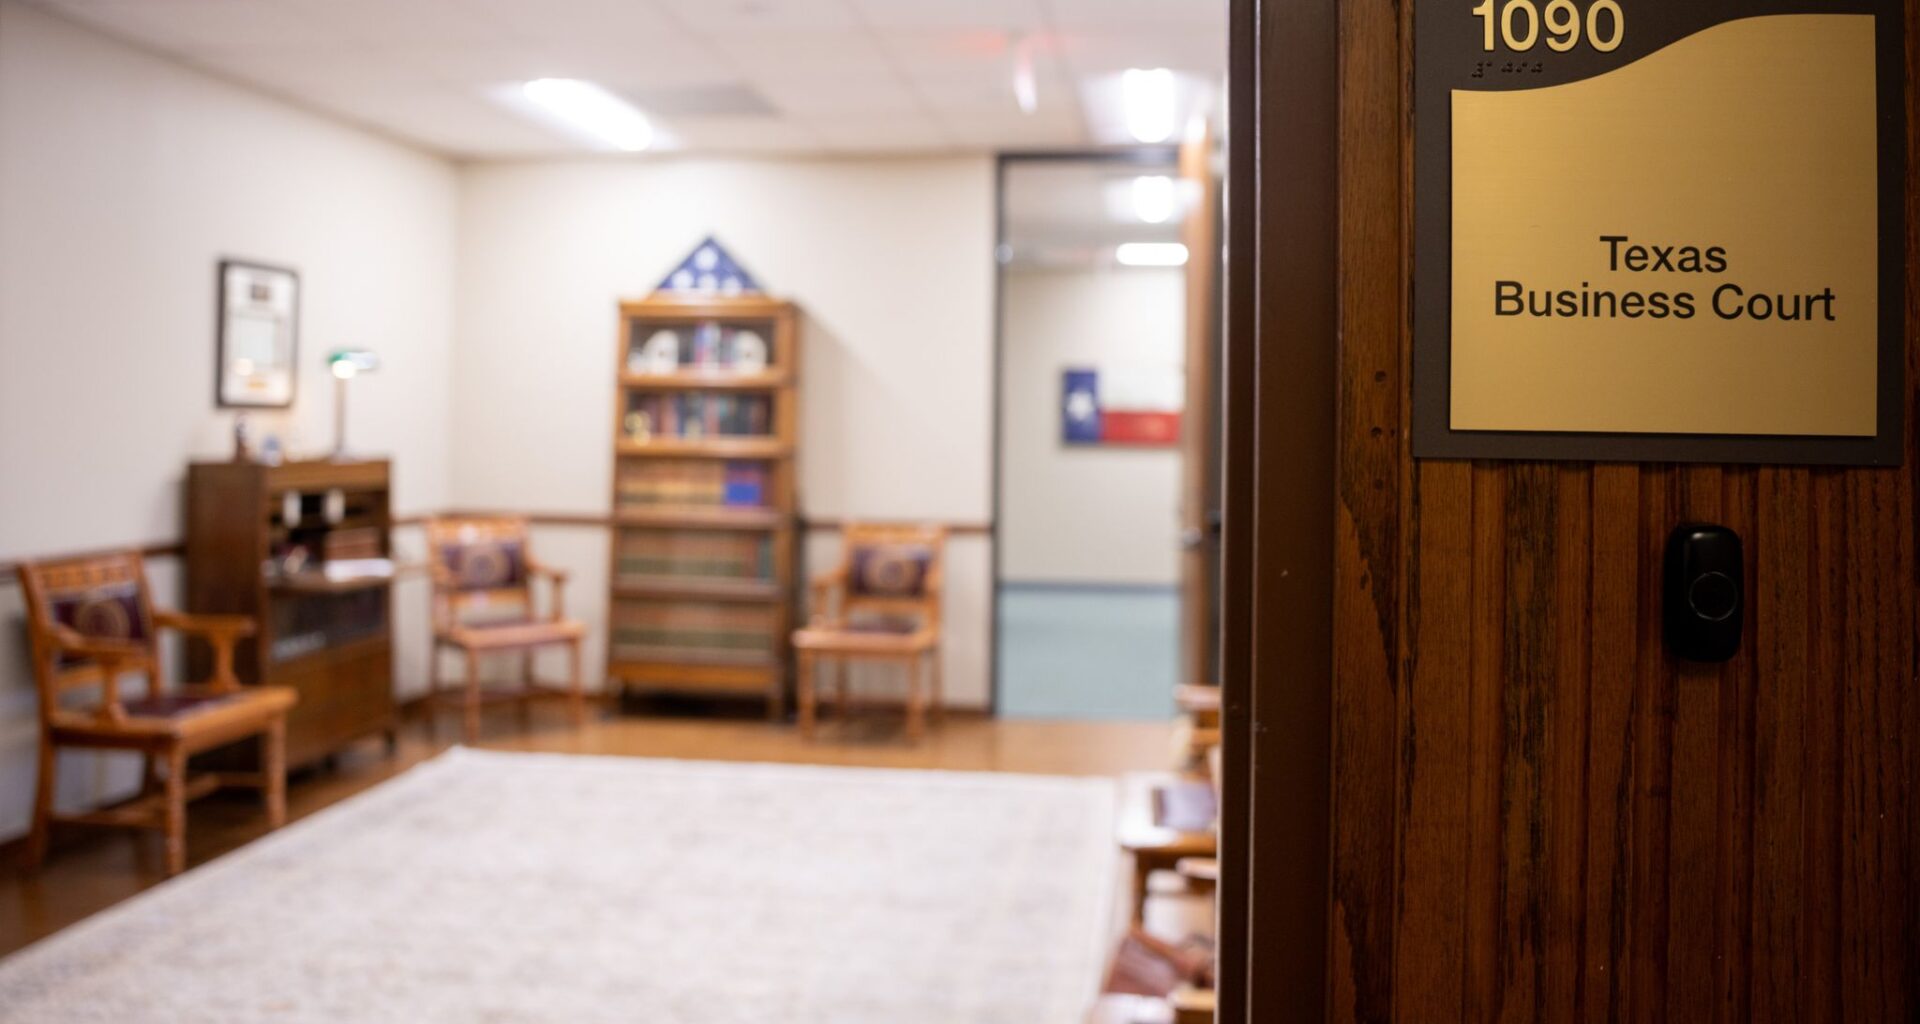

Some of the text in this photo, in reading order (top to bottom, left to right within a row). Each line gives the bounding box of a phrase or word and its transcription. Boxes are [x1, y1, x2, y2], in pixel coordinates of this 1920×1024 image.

[1472, 0, 1625, 53] 1090
[1599, 235, 1728, 274] Texas
[1494, 280, 1837, 322] Business Court
